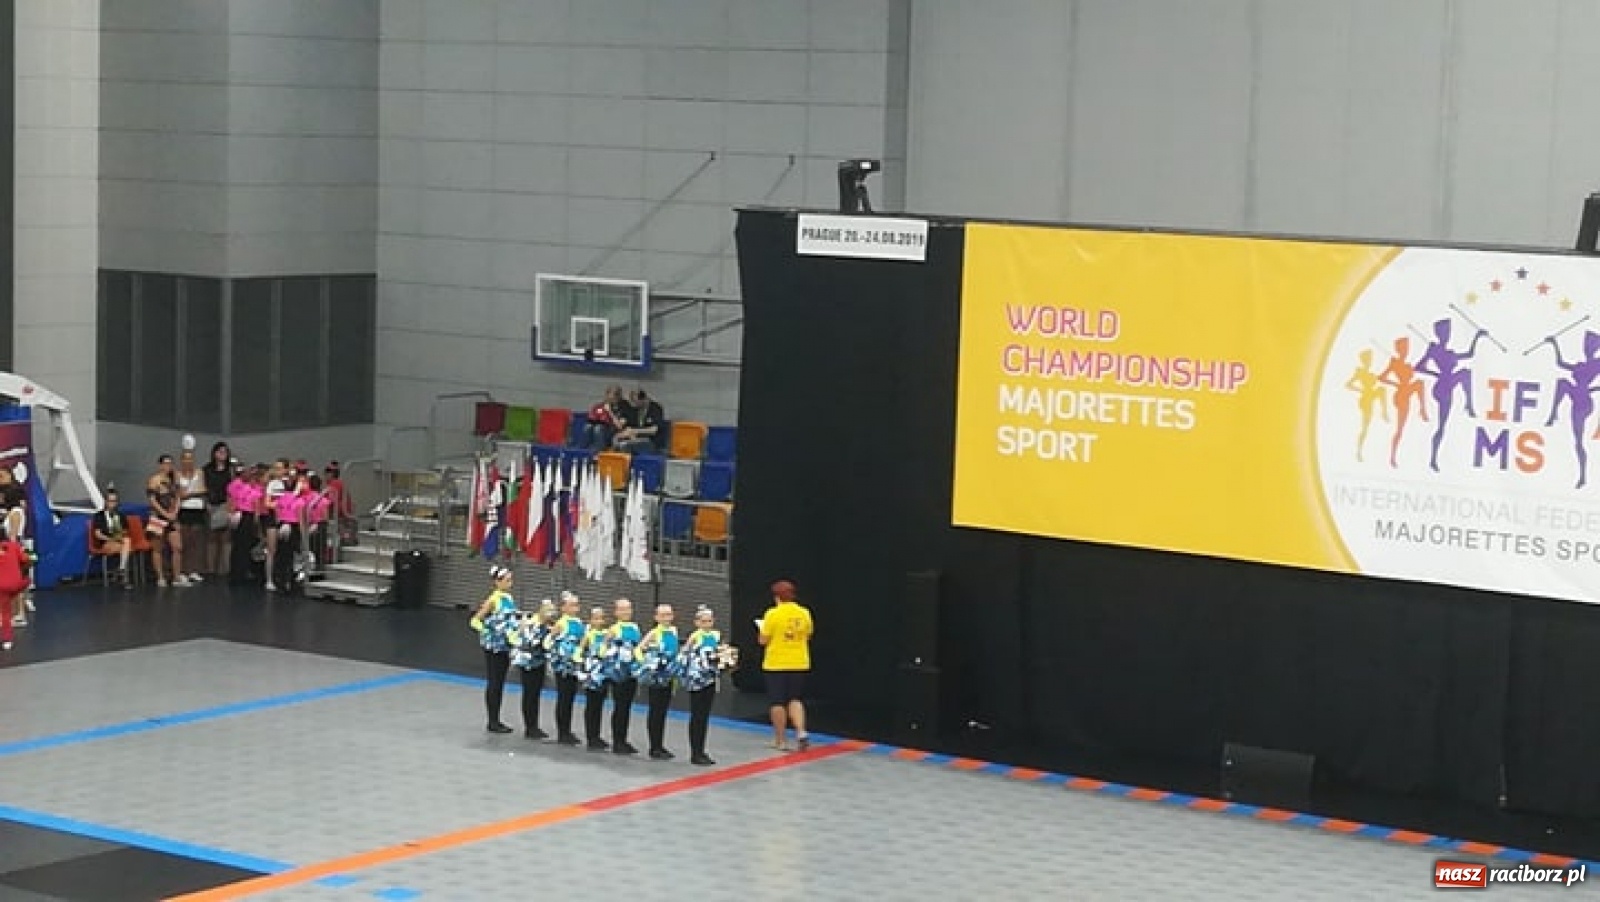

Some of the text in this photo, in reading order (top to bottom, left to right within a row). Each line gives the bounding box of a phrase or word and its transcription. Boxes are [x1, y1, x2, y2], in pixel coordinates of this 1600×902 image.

[801, 227, 841, 242] PRAGUE
[1005, 302, 1120, 342] WORLD
[1002, 344, 1247, 392] CHAMPIONSHIP
[998, 384, 1196, 430] MAJORETTES
[997, 425, 1098, 463] SPORT
[1473, 425, 1546, 474] MS
[1334, 484, 1525, 525] INTERNATIONAL
[1374, 519, 1546, 558] MAJORETTES
